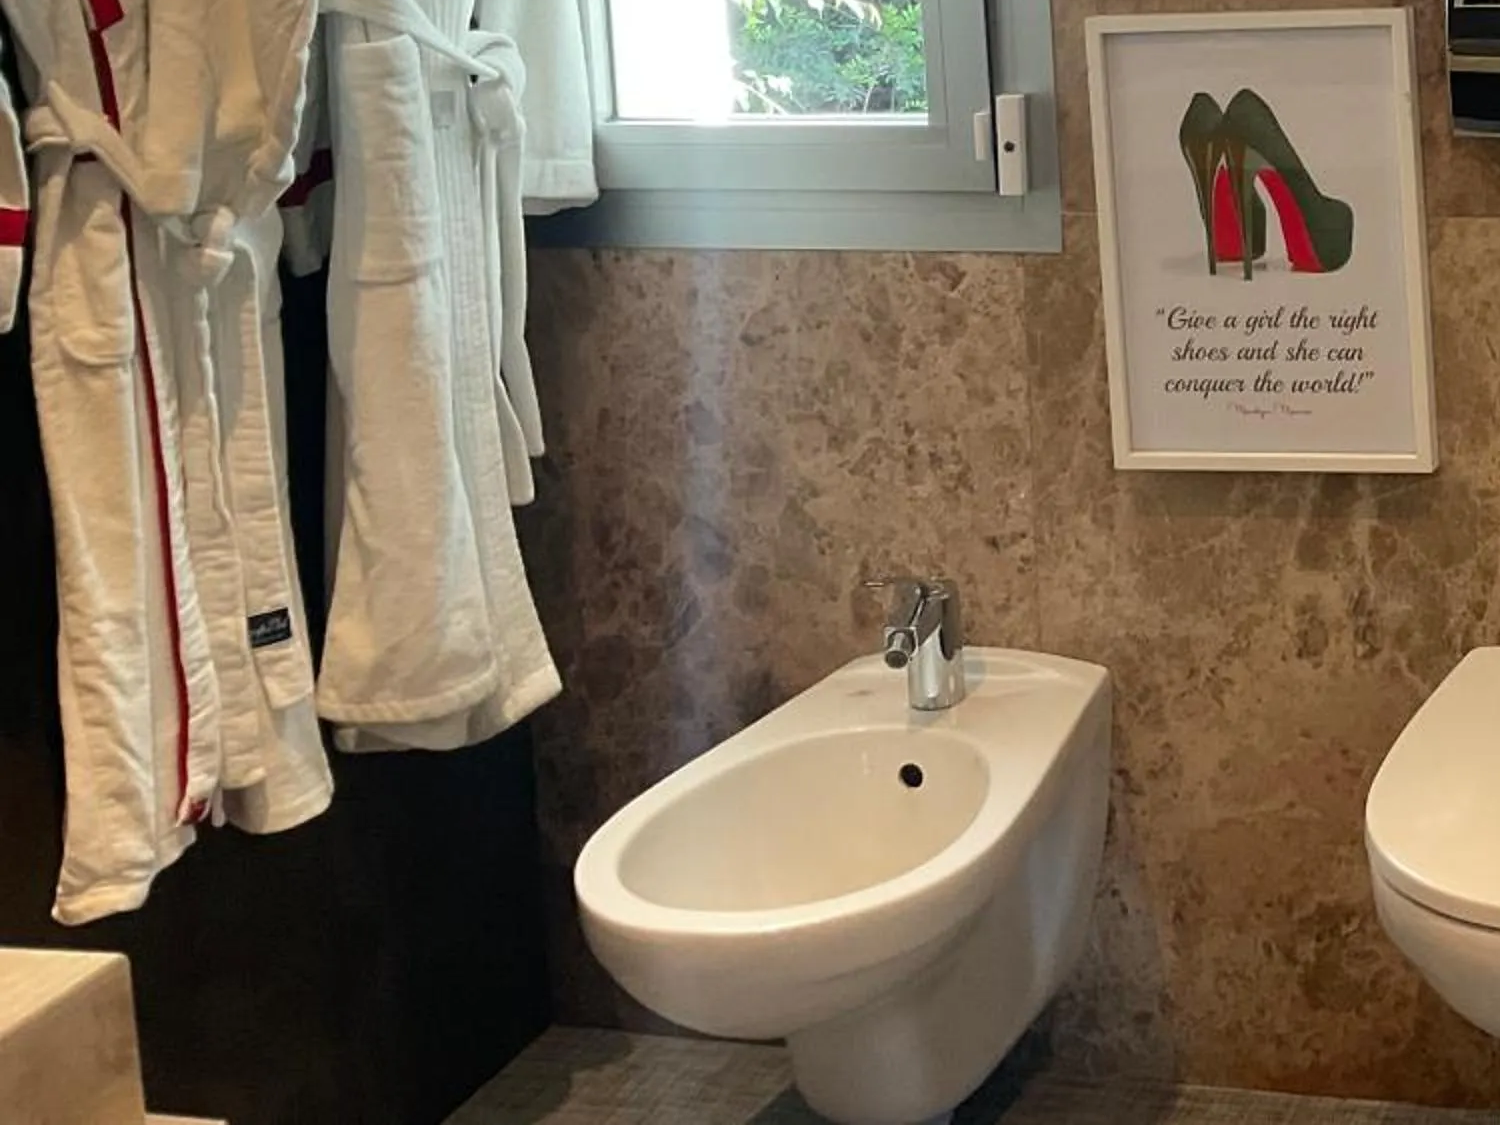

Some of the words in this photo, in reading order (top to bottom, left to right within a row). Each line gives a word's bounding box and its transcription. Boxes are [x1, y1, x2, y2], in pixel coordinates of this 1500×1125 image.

[1223, 314, 1238, 329] a
[1245, 306, 1285, 335] girl
[1289, 306, 1321, 329] the
[1329, 305, 1377, 335] right
[1171, 338, 1229, 361] shoes
[1236, 339, 1279, 361] and
[1285, 338, 1322, 361] she
[1327, 346, 1364, 361] can
[1164, 378, 1245, 399] conquer
[1253, 369, 1285, 393] the
